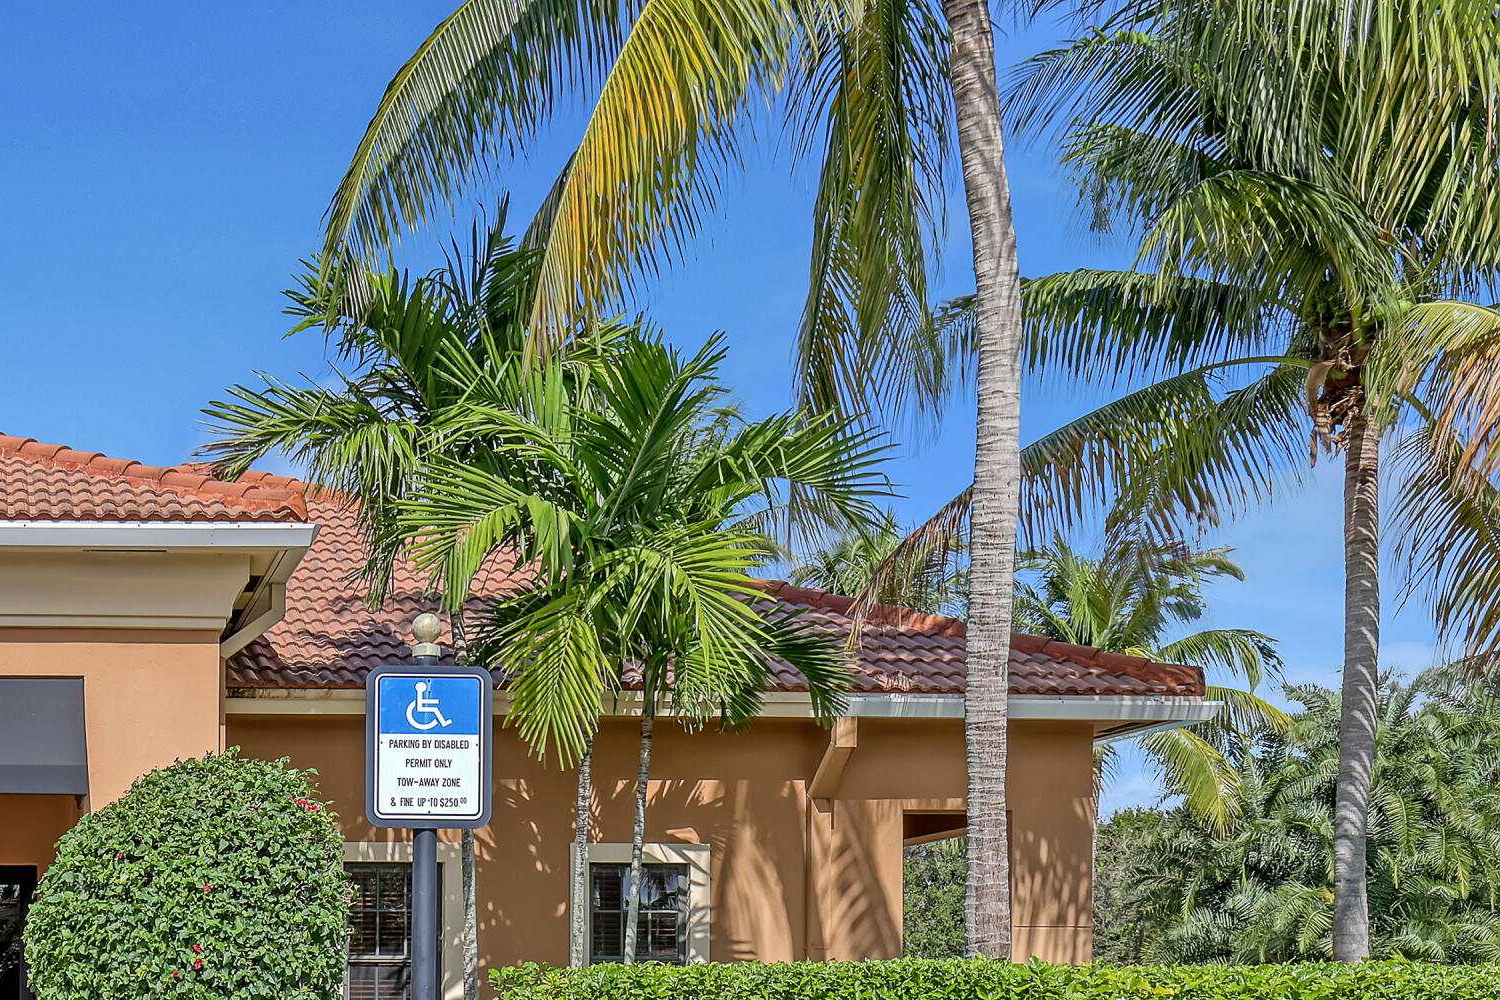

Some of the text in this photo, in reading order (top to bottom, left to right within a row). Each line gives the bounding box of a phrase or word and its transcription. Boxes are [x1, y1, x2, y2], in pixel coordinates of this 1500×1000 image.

[388, 739, 470, 750] PARKING BY DISABLED
[405, 758, 452, 768] PERMIT ONLY
[397, 777, 461, 787] TOW-AWAY ZONE
[390, 796, 396, 807] &
[400, 797, 414, 807] FINE
